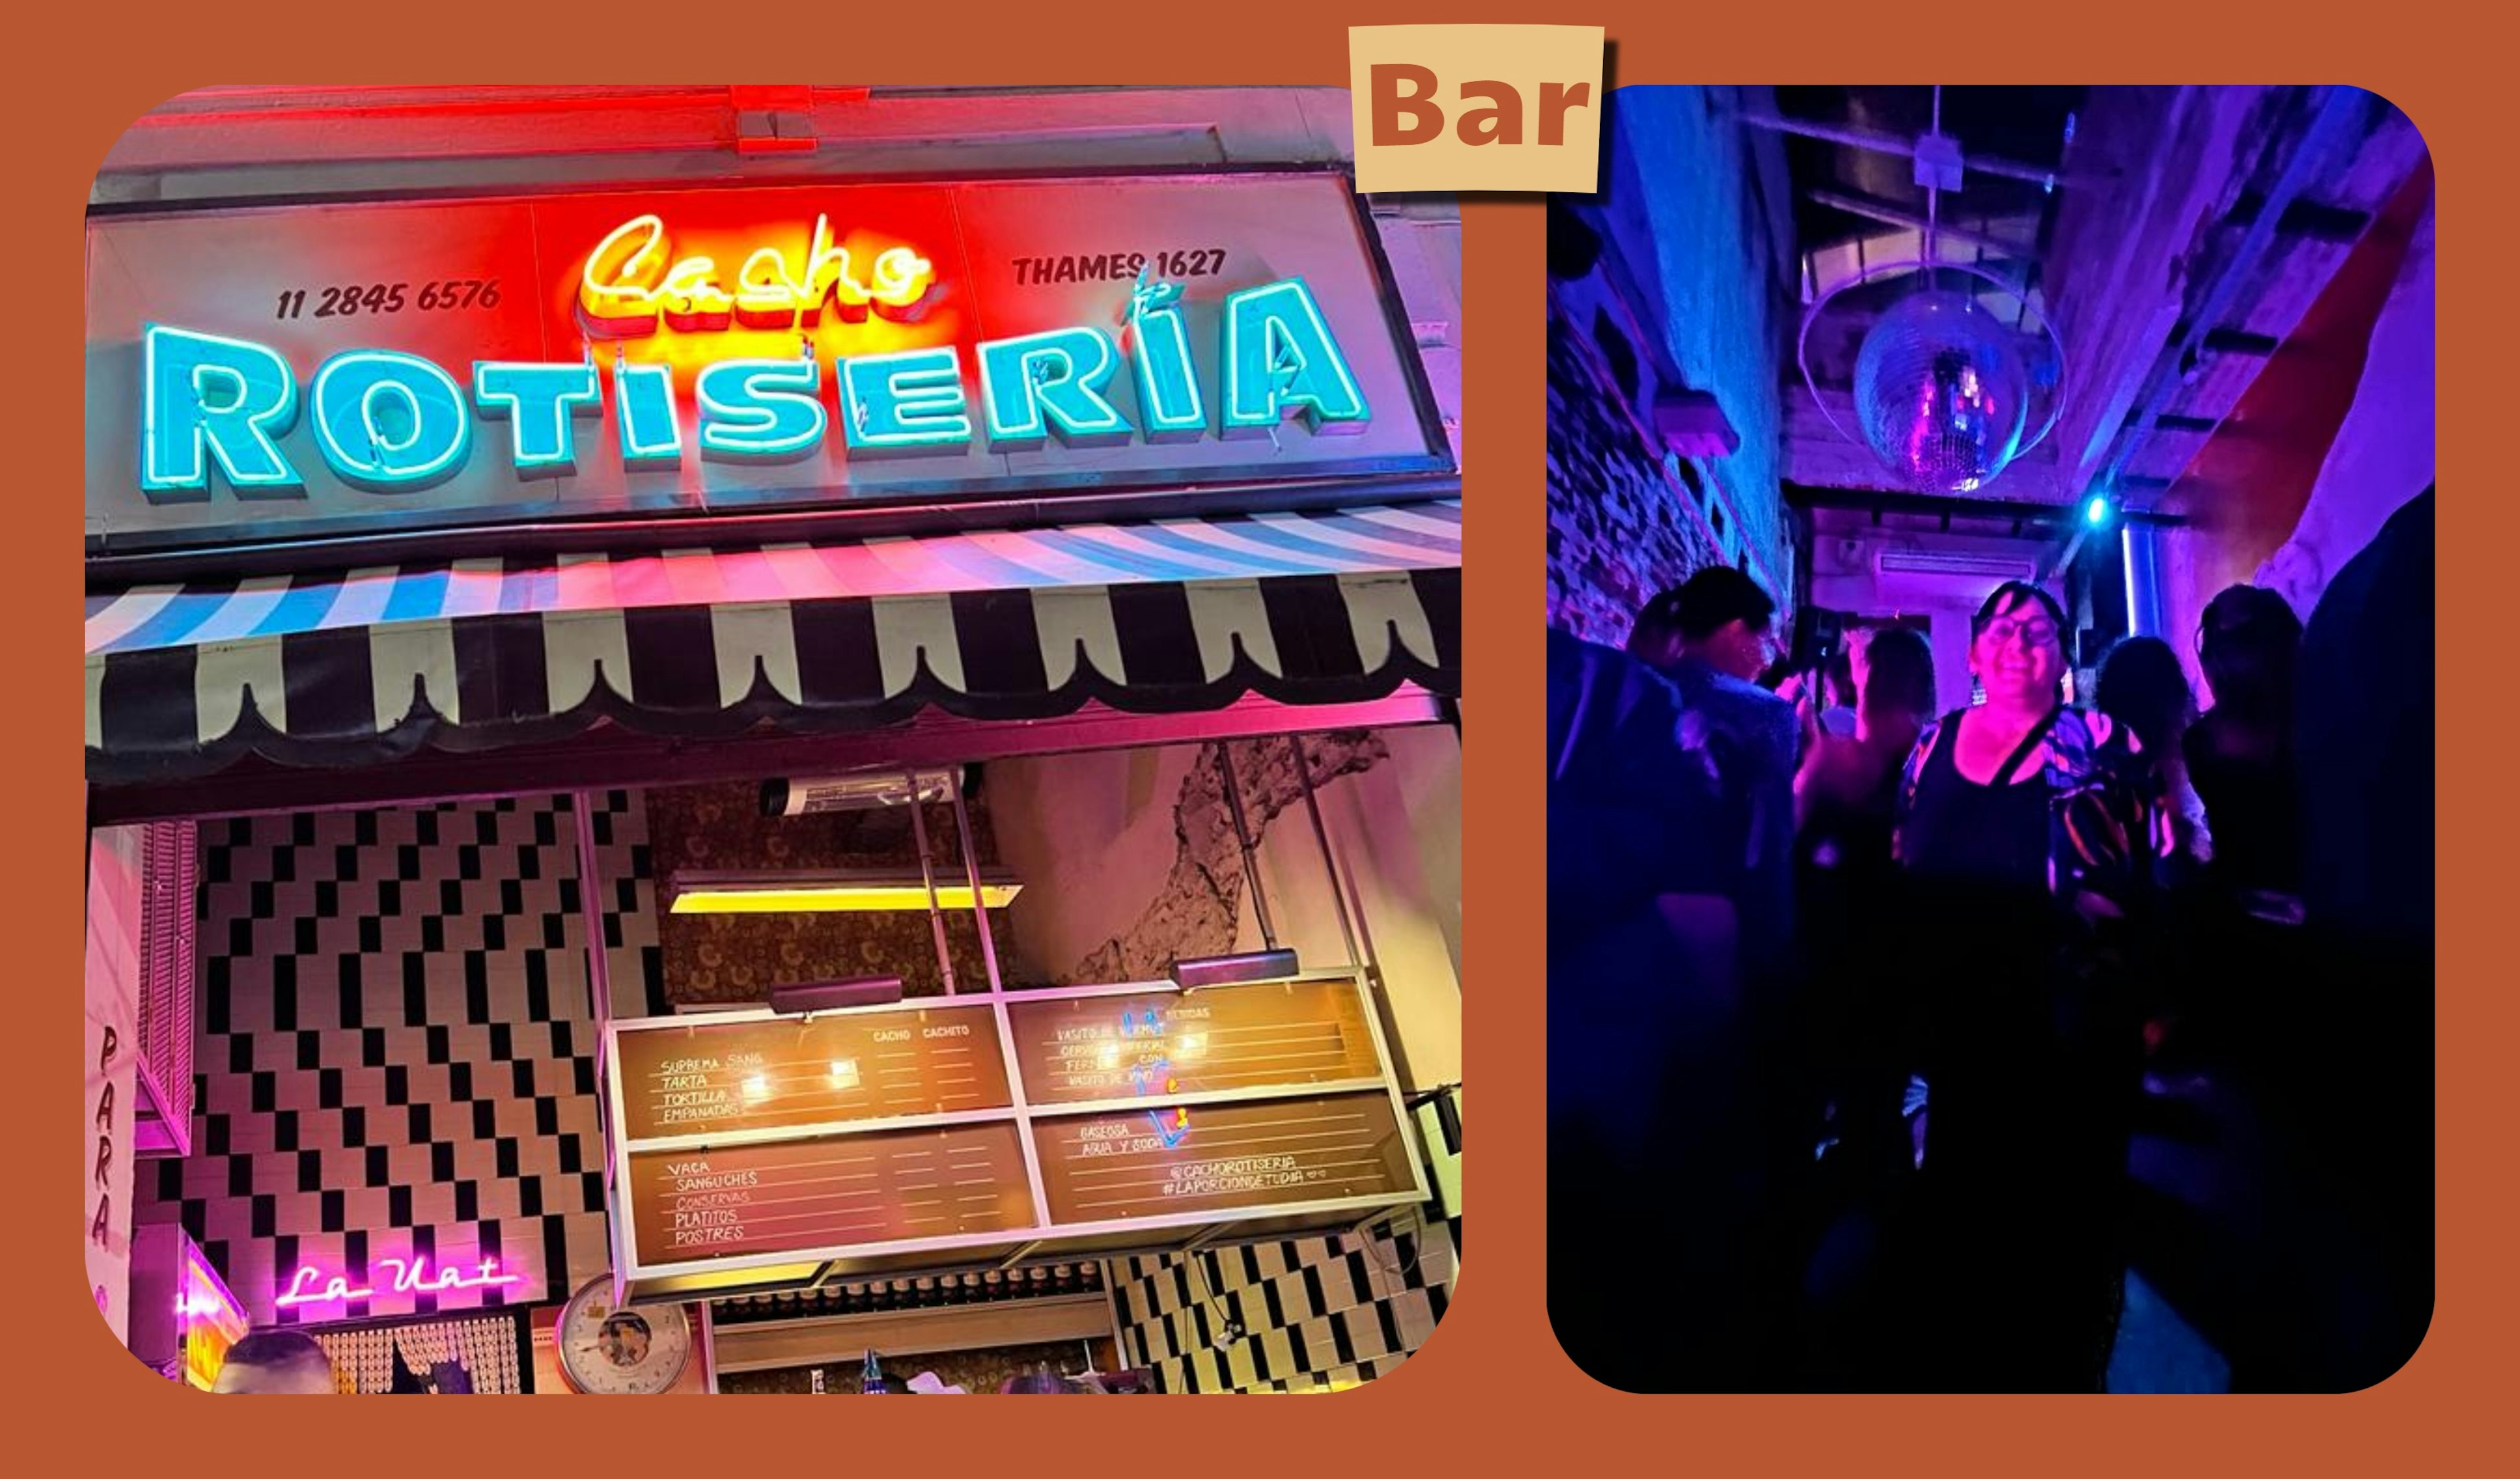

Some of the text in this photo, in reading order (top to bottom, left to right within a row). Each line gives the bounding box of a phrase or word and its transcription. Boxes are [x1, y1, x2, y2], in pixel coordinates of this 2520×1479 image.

[1012, 249, 1227, 285] THAMES 1627
[277, 280, 501, 319] 11 2845 6576
[142, 276, 1373, 502] ROTISERÍA
[873, 1025, 970, 1043] CACHO CACHITO
[662, 1074, 707, 1090] TARTA
[1120, 1140, 1129, 1154] Y
[667, 1162, 710, 1175] VACA
[677, 1171, 757, 1192] SANGUCHES
[675, 1226, 744, 1246] POSTRES
[275, 1266, 374, 1306] La
